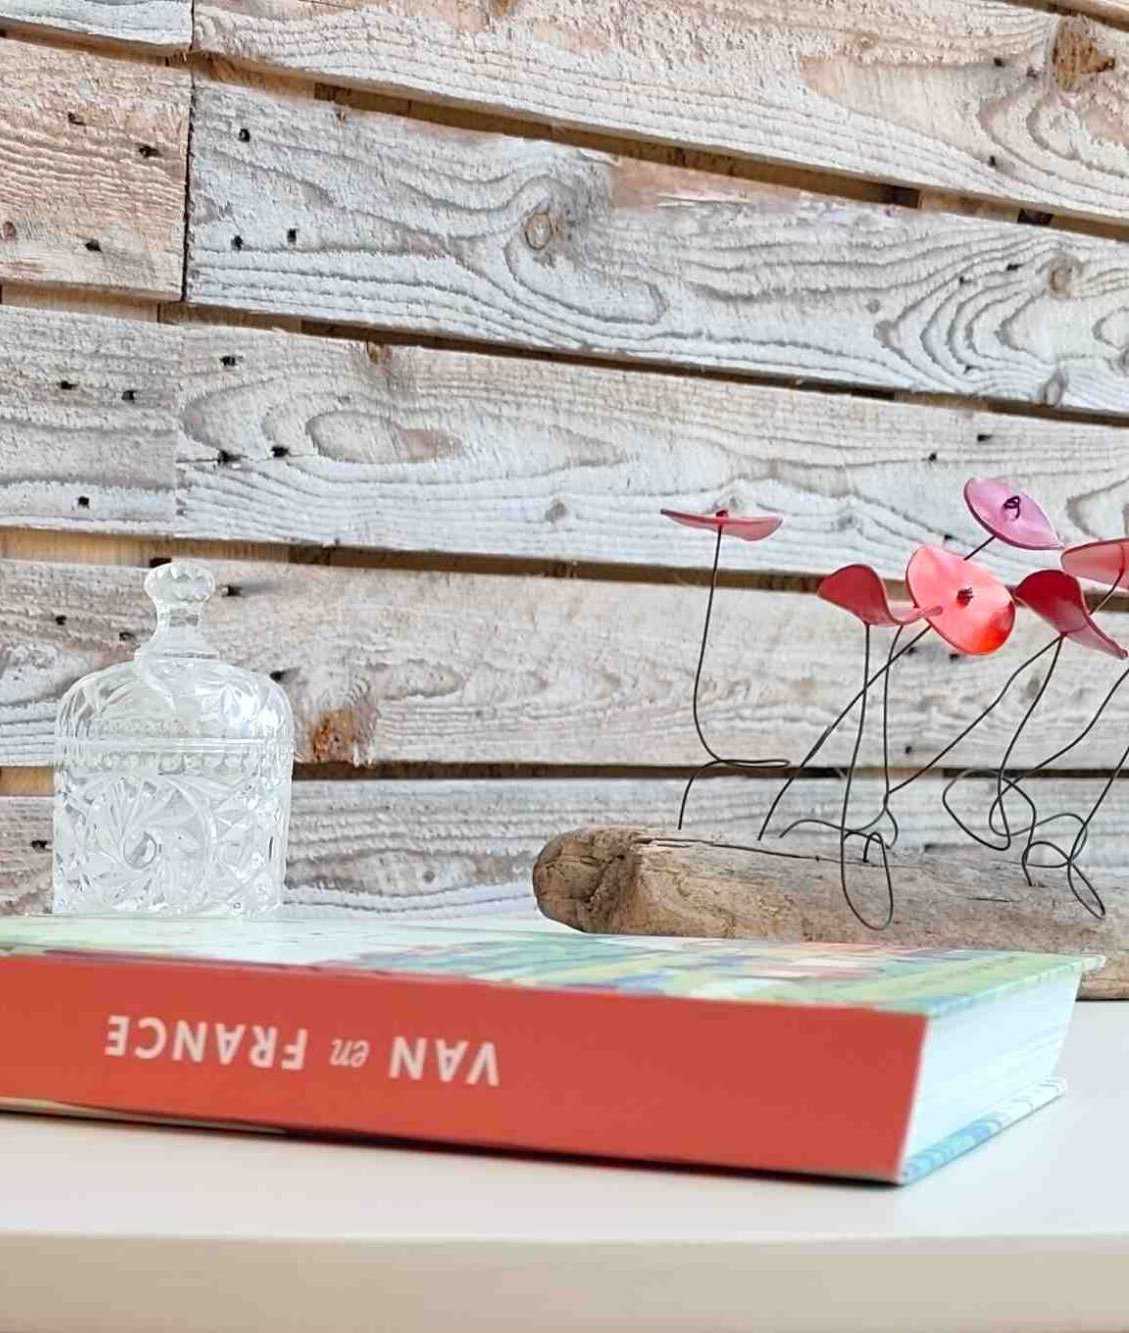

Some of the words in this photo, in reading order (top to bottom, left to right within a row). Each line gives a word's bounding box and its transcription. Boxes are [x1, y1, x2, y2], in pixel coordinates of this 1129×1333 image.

[105, 1015, 307, 1070] FRANCE
[330, 1038, 369, 1067] en
[389, 1036, 499, 1086] VAN
